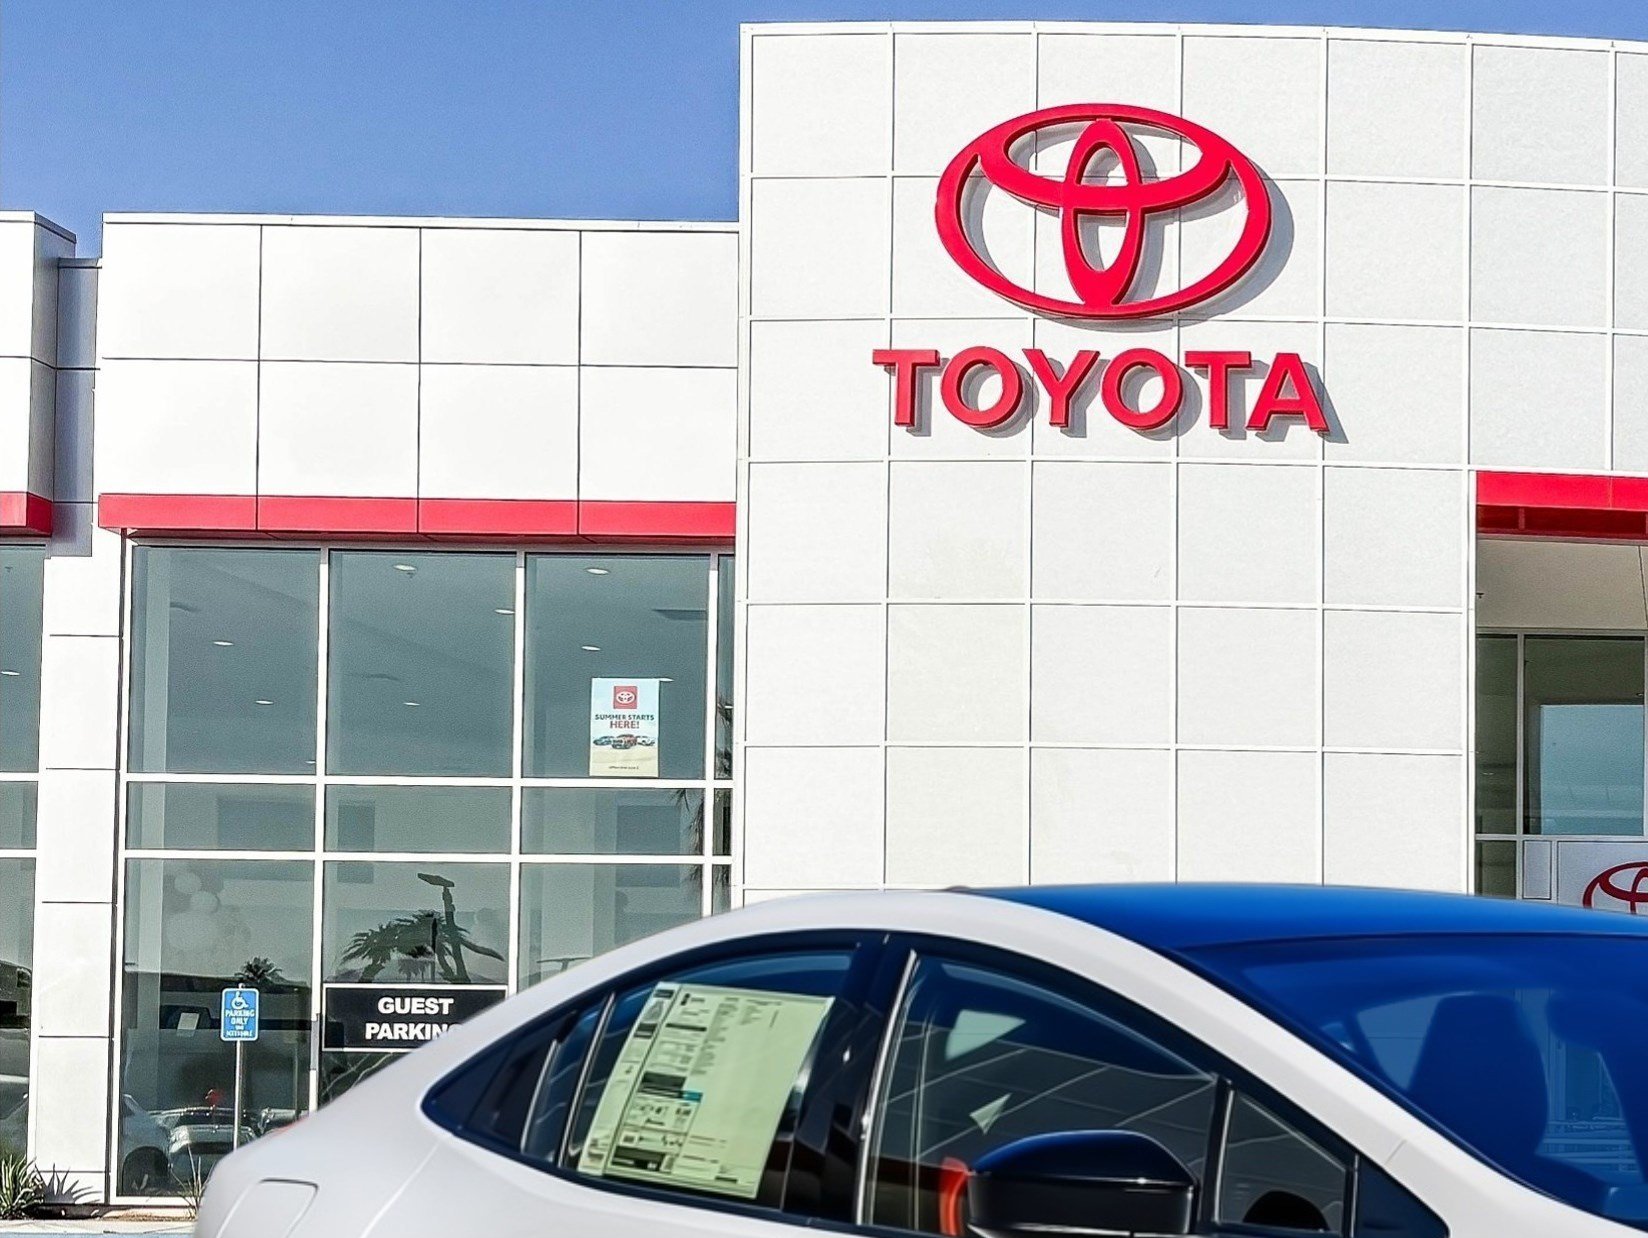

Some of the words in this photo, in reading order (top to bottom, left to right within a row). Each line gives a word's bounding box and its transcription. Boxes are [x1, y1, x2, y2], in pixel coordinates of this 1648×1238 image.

[872, 345, 1329, 433] TOYOTA
[609, 721, 639, 729] HERE!
[377, 997, 455, 1015] GUEST
[225, 1009, 255, 1017] PARKING
[231, 1017, 249, 1025] ONLY
[365, 1022, 461, 1041] PARKIN
